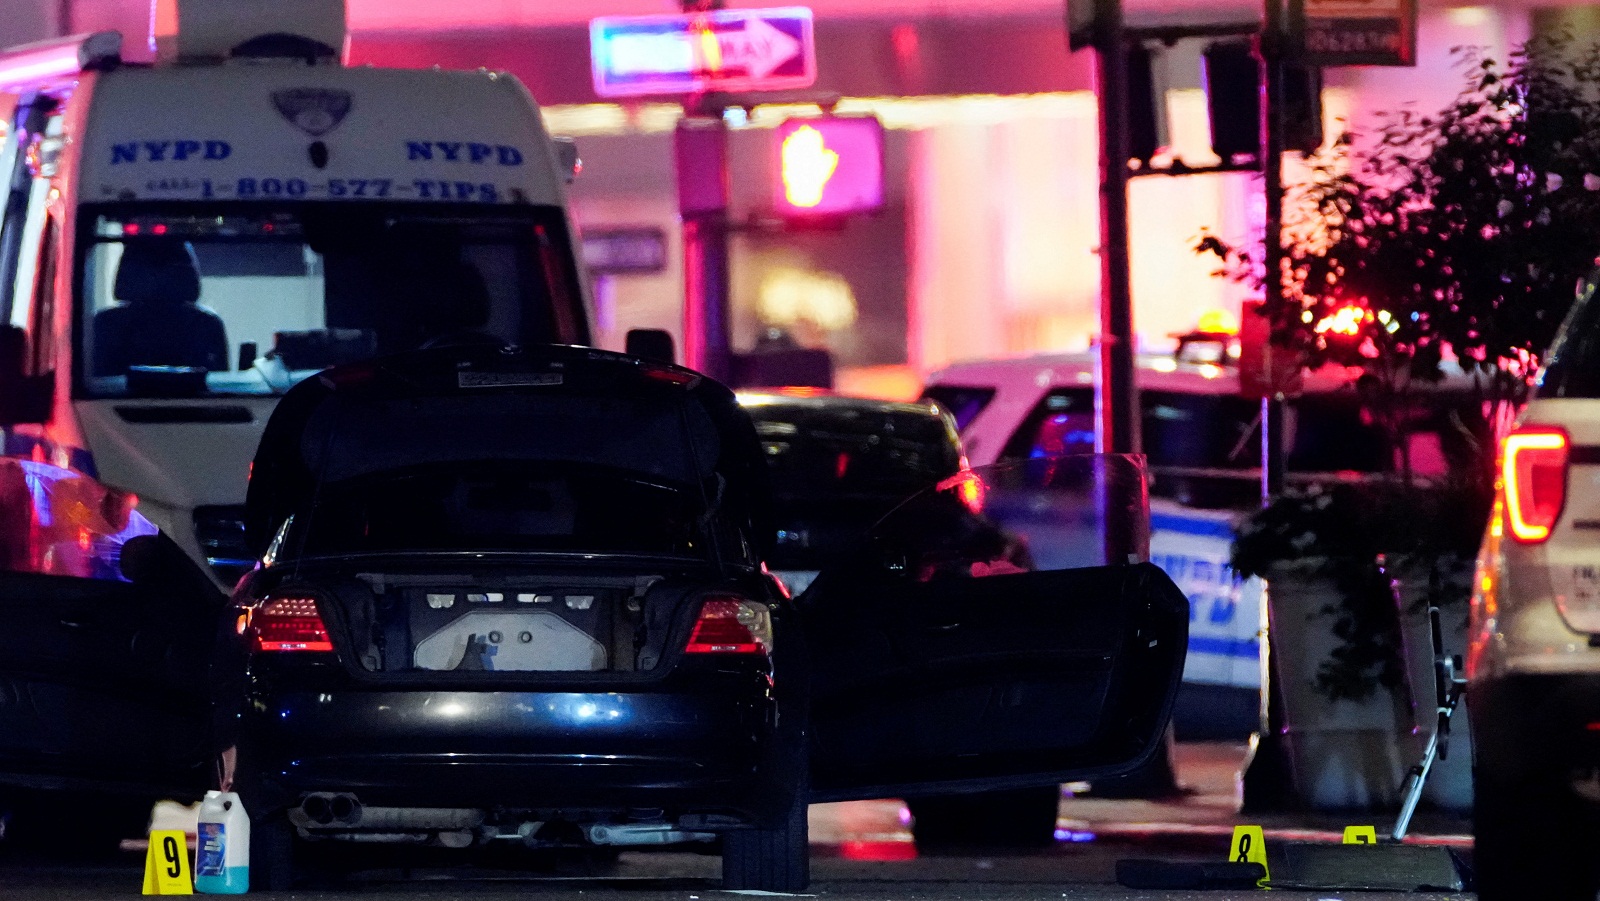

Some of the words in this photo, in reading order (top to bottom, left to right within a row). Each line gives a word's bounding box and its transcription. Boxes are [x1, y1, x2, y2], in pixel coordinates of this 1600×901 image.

[110, 140, 232, 165] NYPD
[406, 141, 524, 166] NYPD
[163, 836, 181, 878] 9
